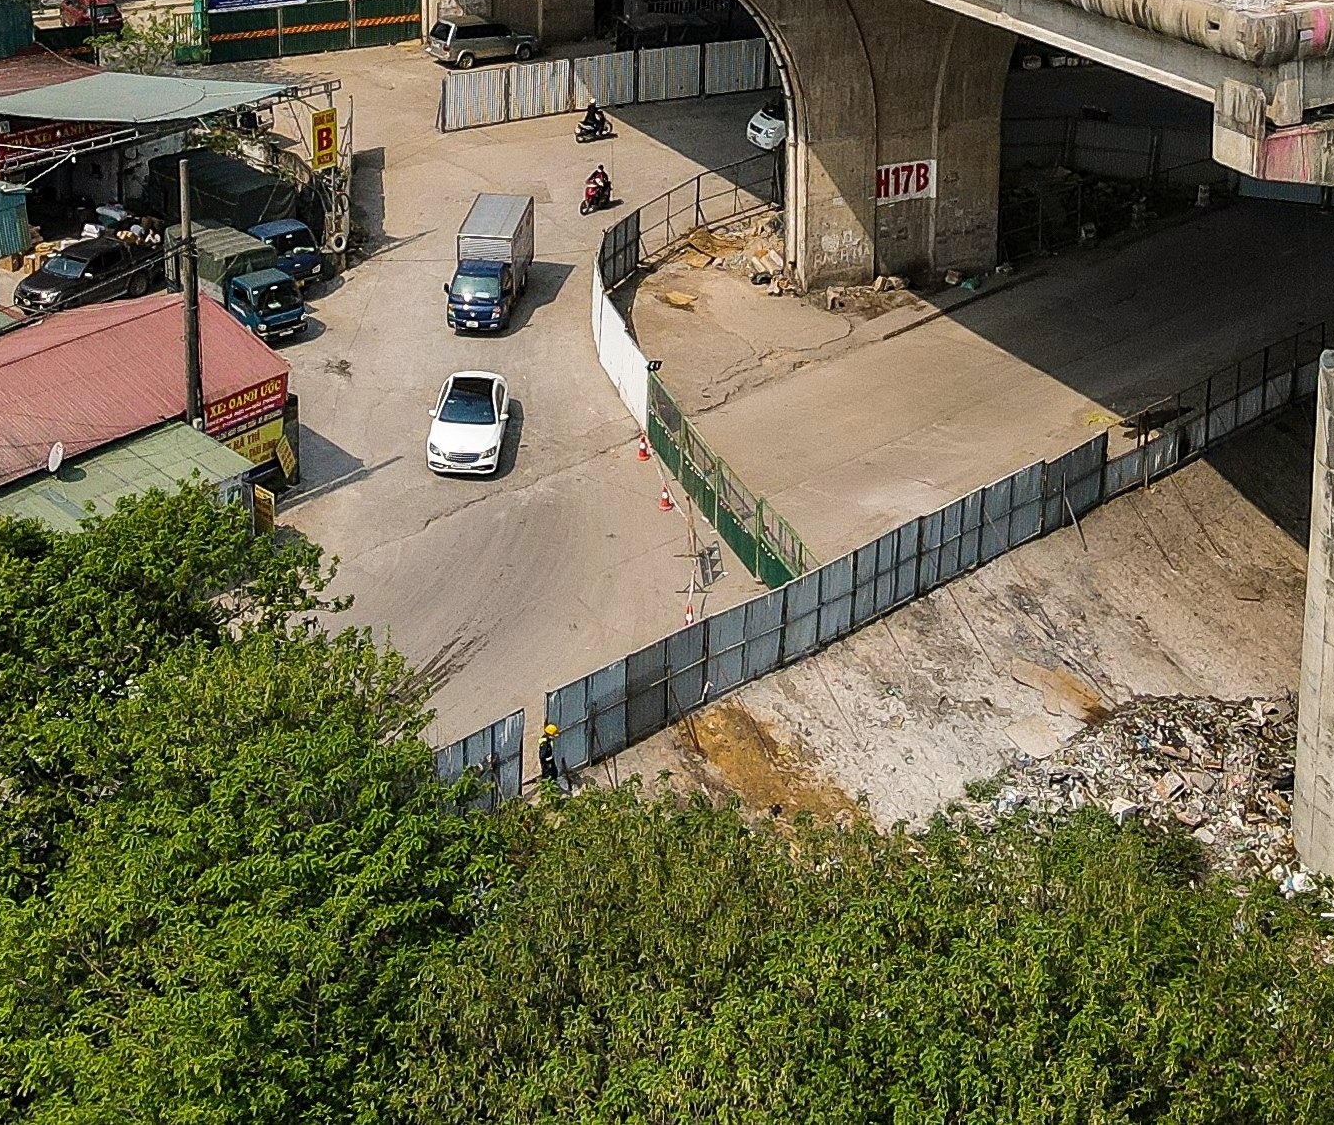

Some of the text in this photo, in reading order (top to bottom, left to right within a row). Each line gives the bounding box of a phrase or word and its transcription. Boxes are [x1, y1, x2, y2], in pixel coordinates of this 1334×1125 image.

[317, 127, 334, 152] B
[877, 162, 930, 198] H17B
[228, 388, 258, 410] OANH
